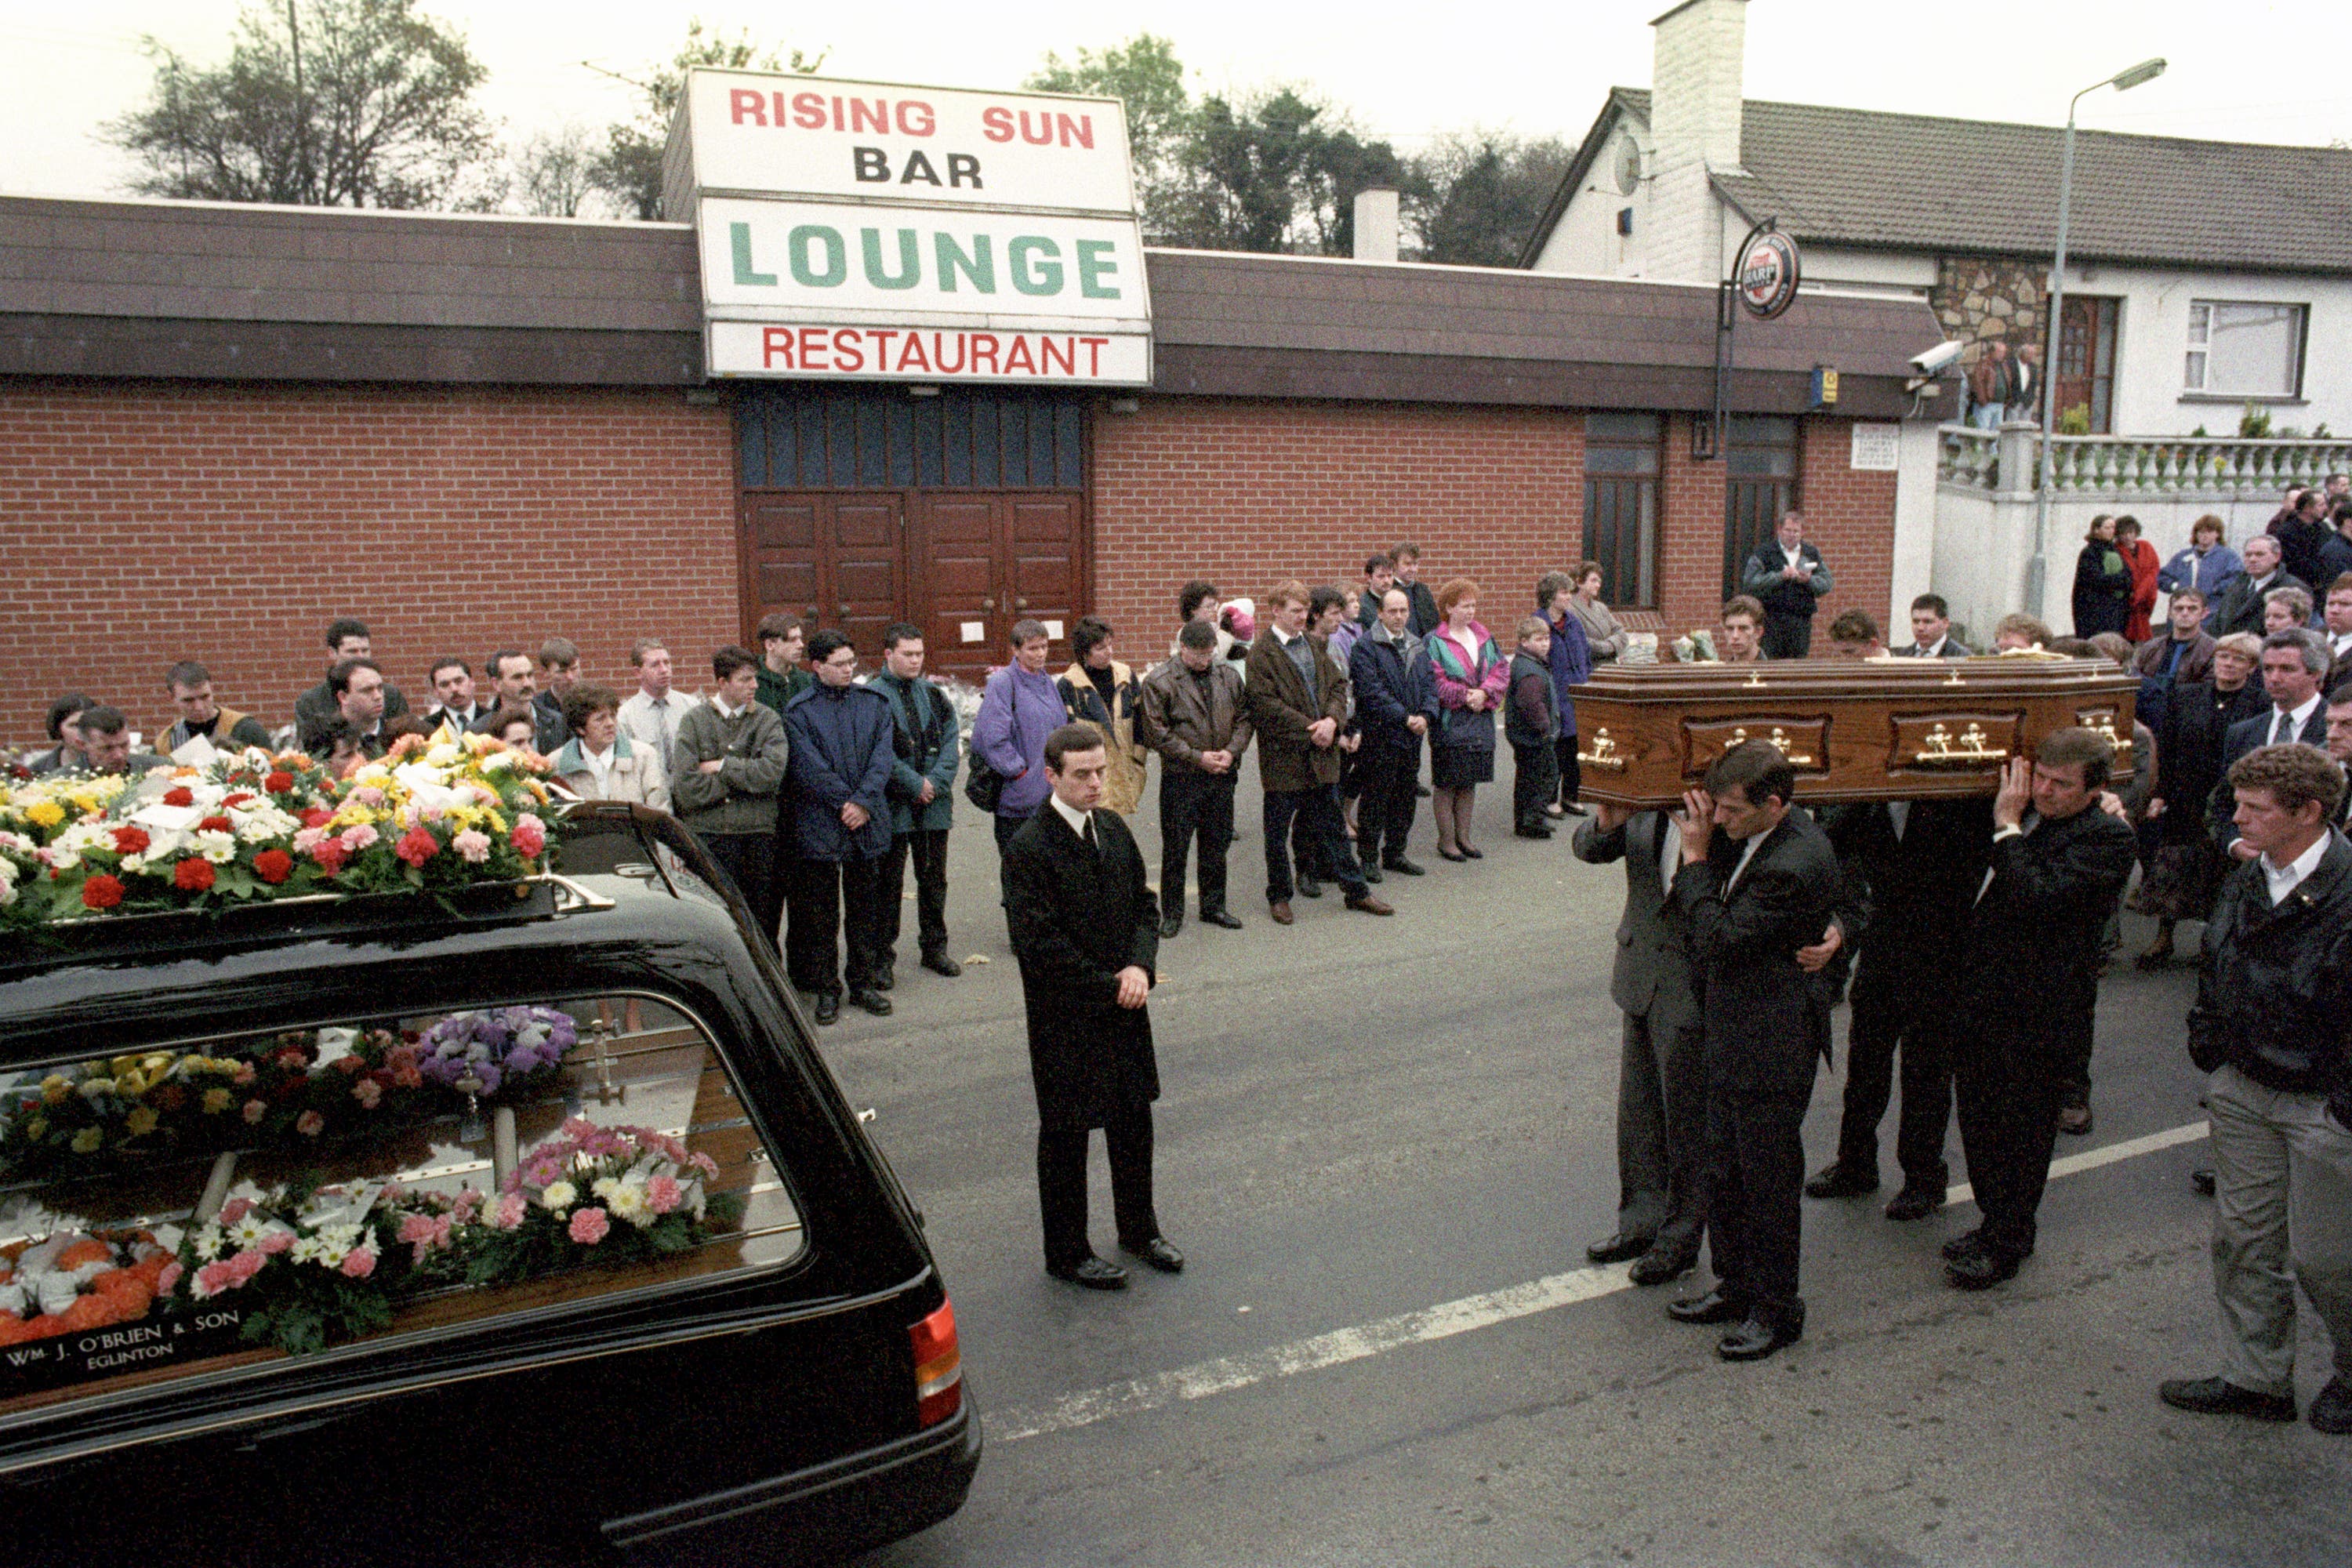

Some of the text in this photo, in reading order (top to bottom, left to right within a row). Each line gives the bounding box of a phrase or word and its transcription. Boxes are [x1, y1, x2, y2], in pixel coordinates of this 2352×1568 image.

[730, 89, 1094, 149] RISING SUN
[853, 147, 983, 189] BAR
[730, 223, 1122, 299] LOUNGE
[762, 327, 1109, 377] RESTAURANT
[78, 1324, 162, 1352] O'BRIEN
[173, 1323, 185, 1334] &
[195, 1310, 239, 1331] SON
[87, 1343, 174, 1370] EGLINTON
